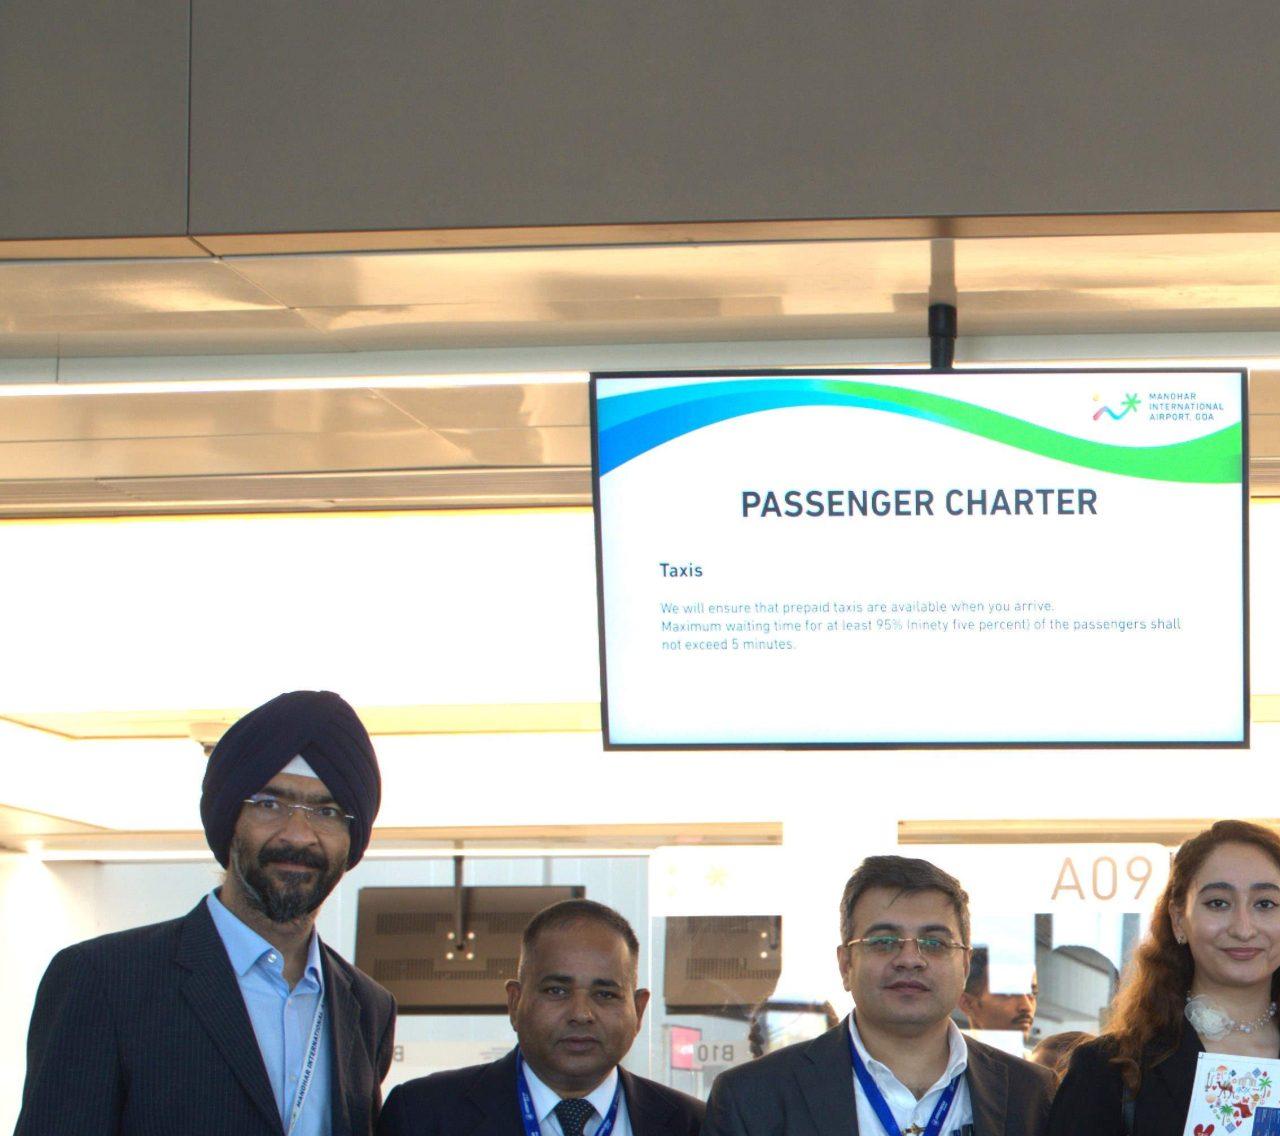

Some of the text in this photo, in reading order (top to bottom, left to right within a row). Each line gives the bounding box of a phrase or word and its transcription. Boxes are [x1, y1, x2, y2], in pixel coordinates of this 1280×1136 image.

[1149, 392, 1197, 400] MANOHAR
[1149, 402, 1223, 411] INTERNATIONAL
[1195, 413, 1214, 421] GOA
[742, 488, 1097, 518] PASSENGER CHARTER
[659, 562, 703, 578] Taxis
[660, 600, 1055, 616] We will ensure that prepaid taxis are available when you arrive.
[661, 621, 722, 633] Maximum
[726, 620, 770, 635] waiting
[774, 620, 802, 632] time
[805, 619, 823, 632] for
[827, 620, 838, 631] at
[842, 619, 873, 631] least
[876, 618, 903, 631] 95%
[953, 618, 976, 631] five
[1034, 618, 1047, 631] of
[1050, 618, 1070, 631] the
[1073, 619, 1147, 633] passengers
[1150, 618, 1182, 631] shall
[662, 638, 796, 650] not exceed 5 minutes.
[1051, 856, 1153, 900] A09
